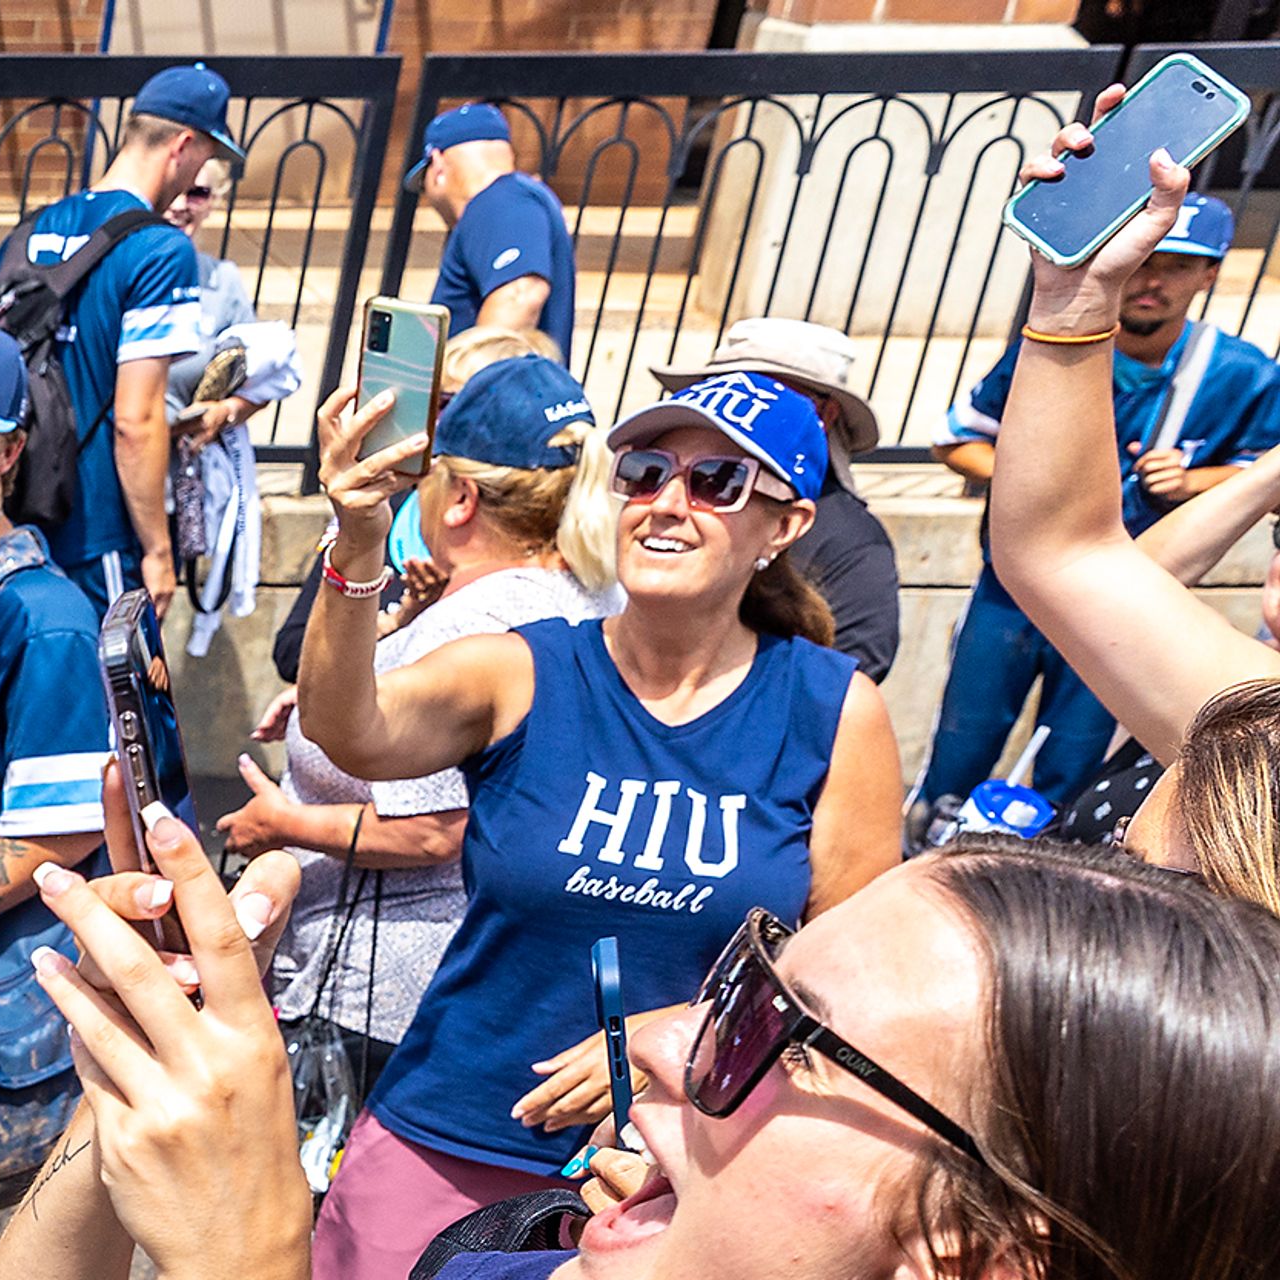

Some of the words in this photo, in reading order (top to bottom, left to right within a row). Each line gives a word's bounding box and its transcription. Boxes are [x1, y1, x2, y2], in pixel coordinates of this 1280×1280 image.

[557, 771, 747, 879] HIU
[564, 865, 714, 914] baseball
[836, 1046, 877, 1077] QUAY
